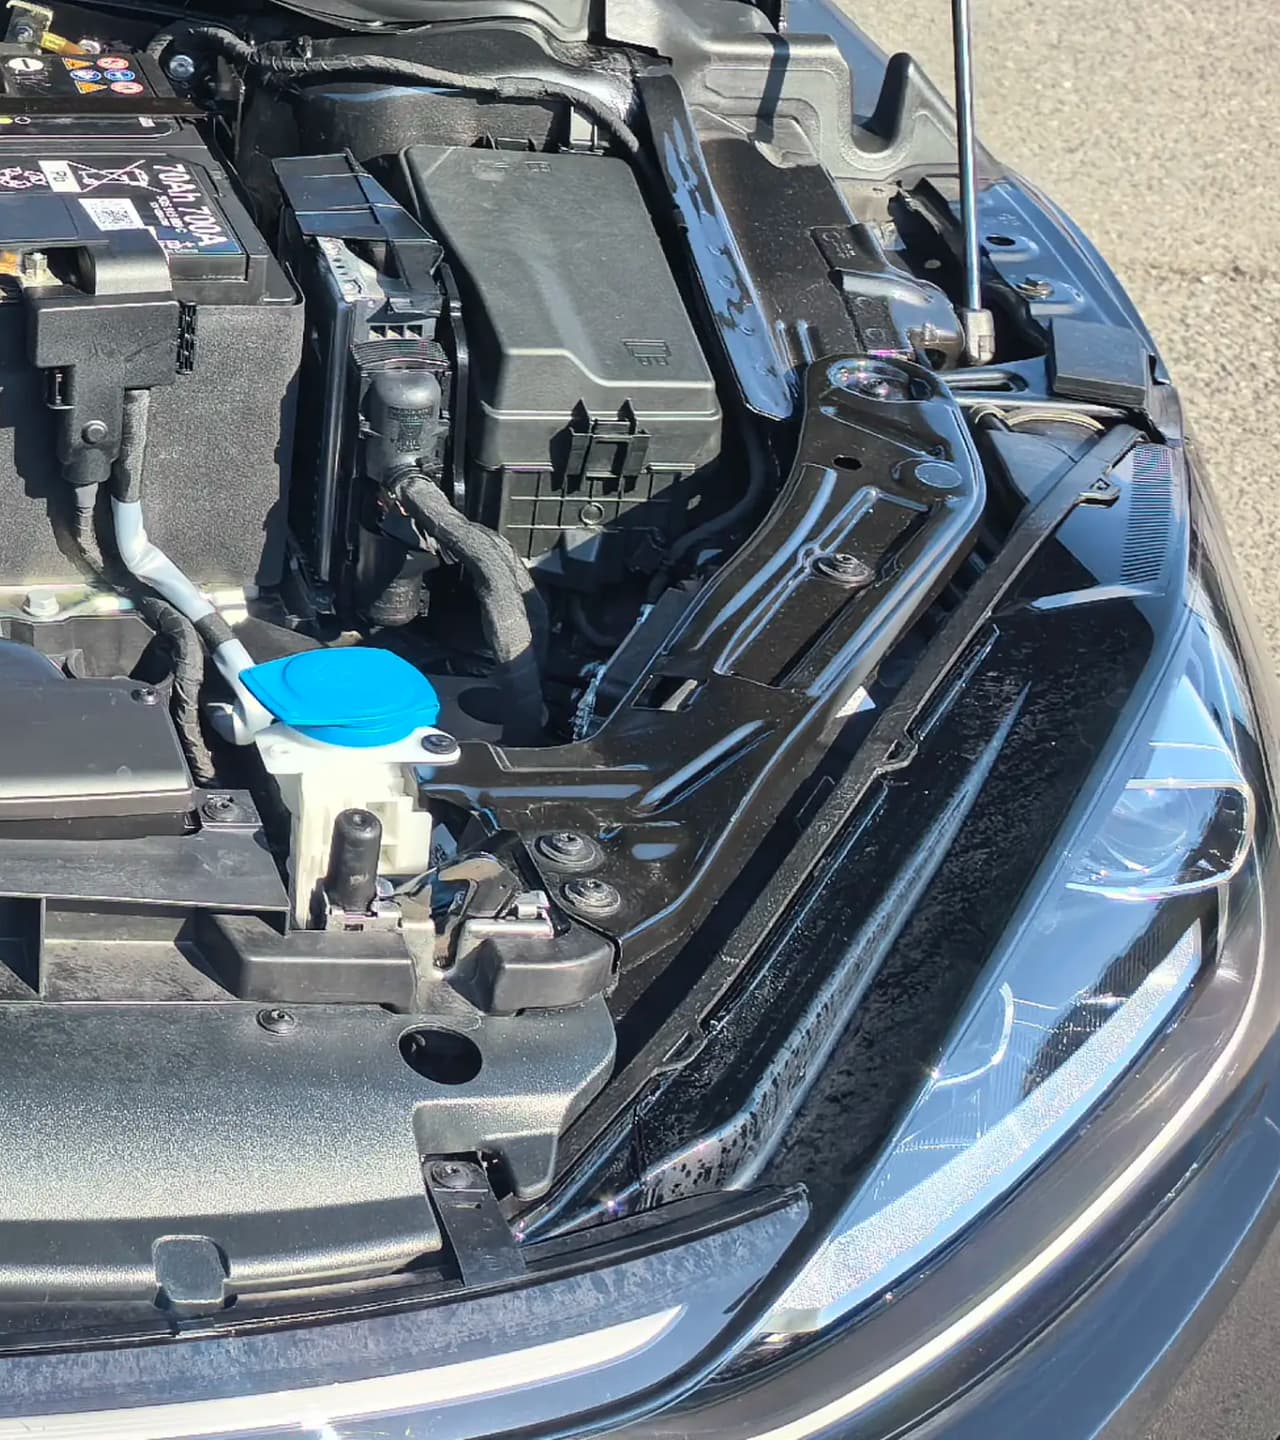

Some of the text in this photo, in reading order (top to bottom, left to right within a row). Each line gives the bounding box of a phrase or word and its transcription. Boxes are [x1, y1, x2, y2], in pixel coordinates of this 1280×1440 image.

[52, 170, 68, 182] Pb
[153, 164, 201, 202] 70Ah
[178, 205, 229, 246] 700A
